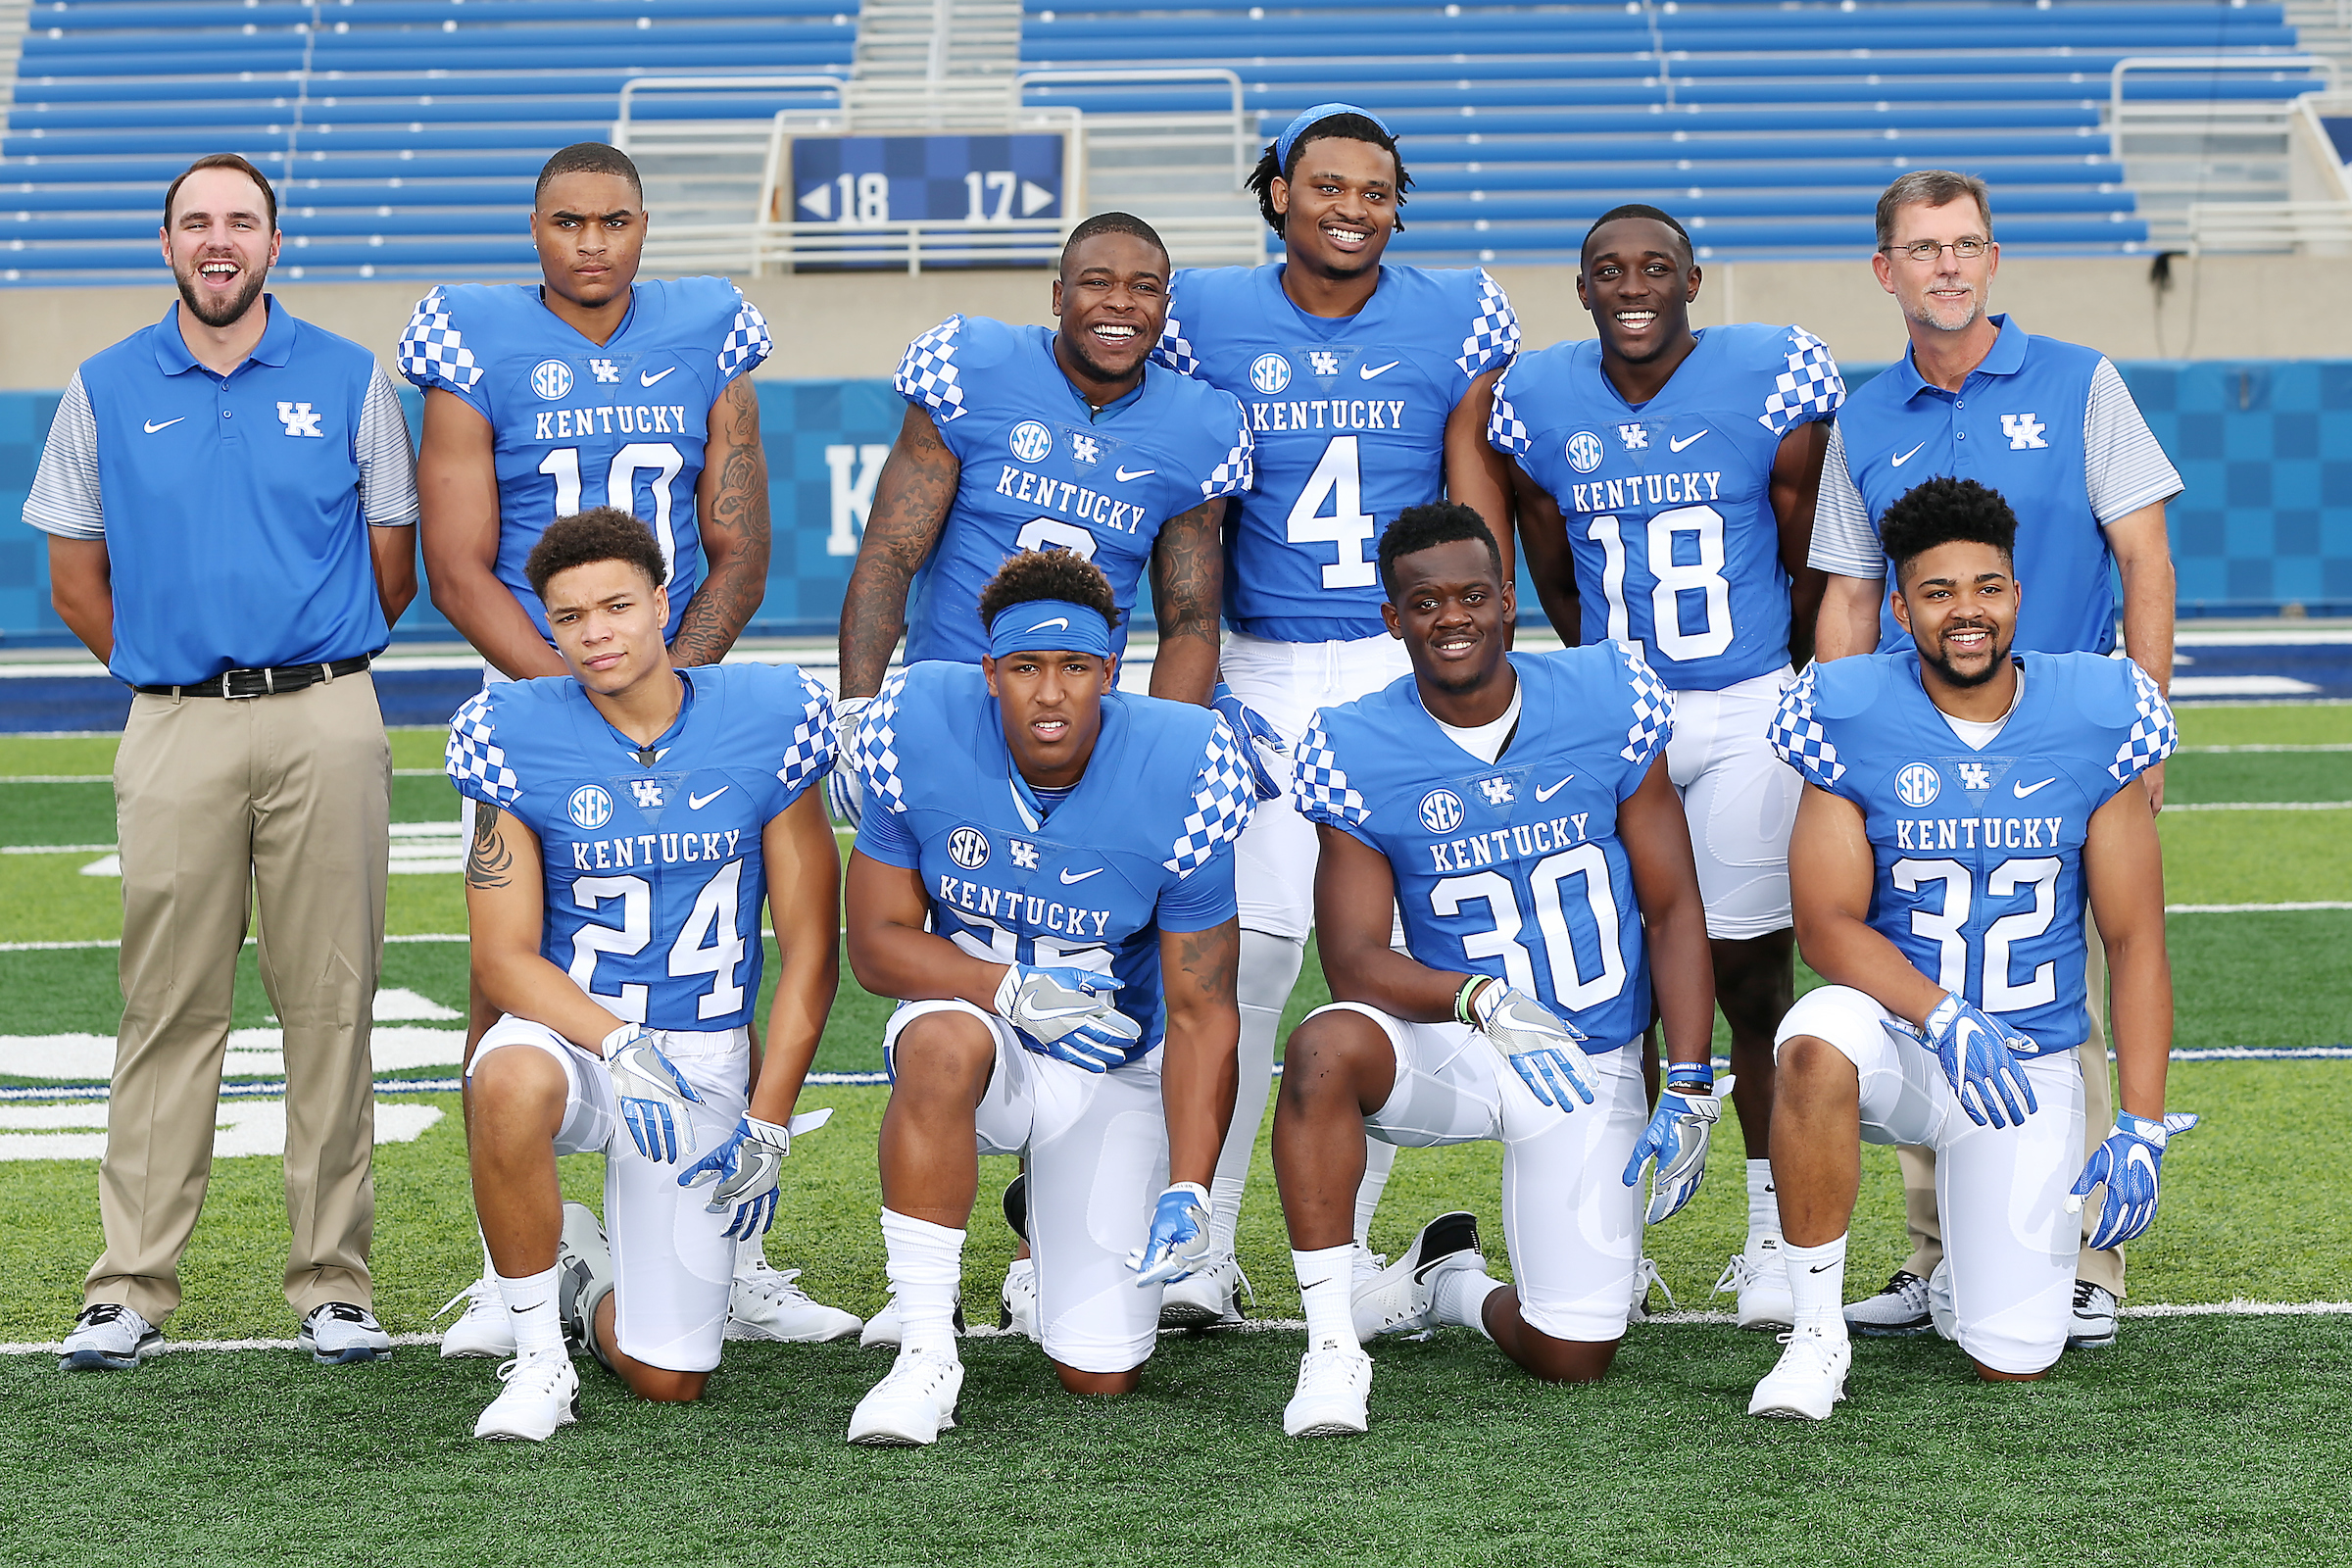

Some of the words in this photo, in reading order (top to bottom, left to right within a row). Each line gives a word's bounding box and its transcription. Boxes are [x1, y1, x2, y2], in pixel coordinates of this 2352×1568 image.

[836, 172, 889, 224] 18
[963, 171, 1017, 224] 17
[533, 363, 572, 397] SEC
[1252, 355, 1290, 392] SEC
[535, 405, 685, 440] KENTUCKY
[1251, 400, 1405, 431] KENTUCKY
[1012, 423, 1049, 460] SEC
[1568, 434, 1601, 470] SEC
[996, 465, 1146, 535] KENTUCKY
[1287, 435, 1377, 589] 4
[1572, 471, 1721, 513] KENTUCKY
[539, 443, 684, 588] 10
[1587, 504, 1735, 662] 18
[1899, 764, 1937, 804] SEC
[571, 789, 610, 826] SEC
[1422, 793, 1463, 831] SEC
[571, 829, 740, 871] KENTUCKY
[952, 830, 987, 867] SEC
[1429, 812, 1590, 872] KENTUCKY
[1895, 816, 2063, 852] KENTUCKY
[939, 874, 1110, 937] KENTUCKY
[568, 858, 745, 1024] 24
[1429, 842, 1628, 1013] 30
[1891, 856, 2063, 1013] 32
